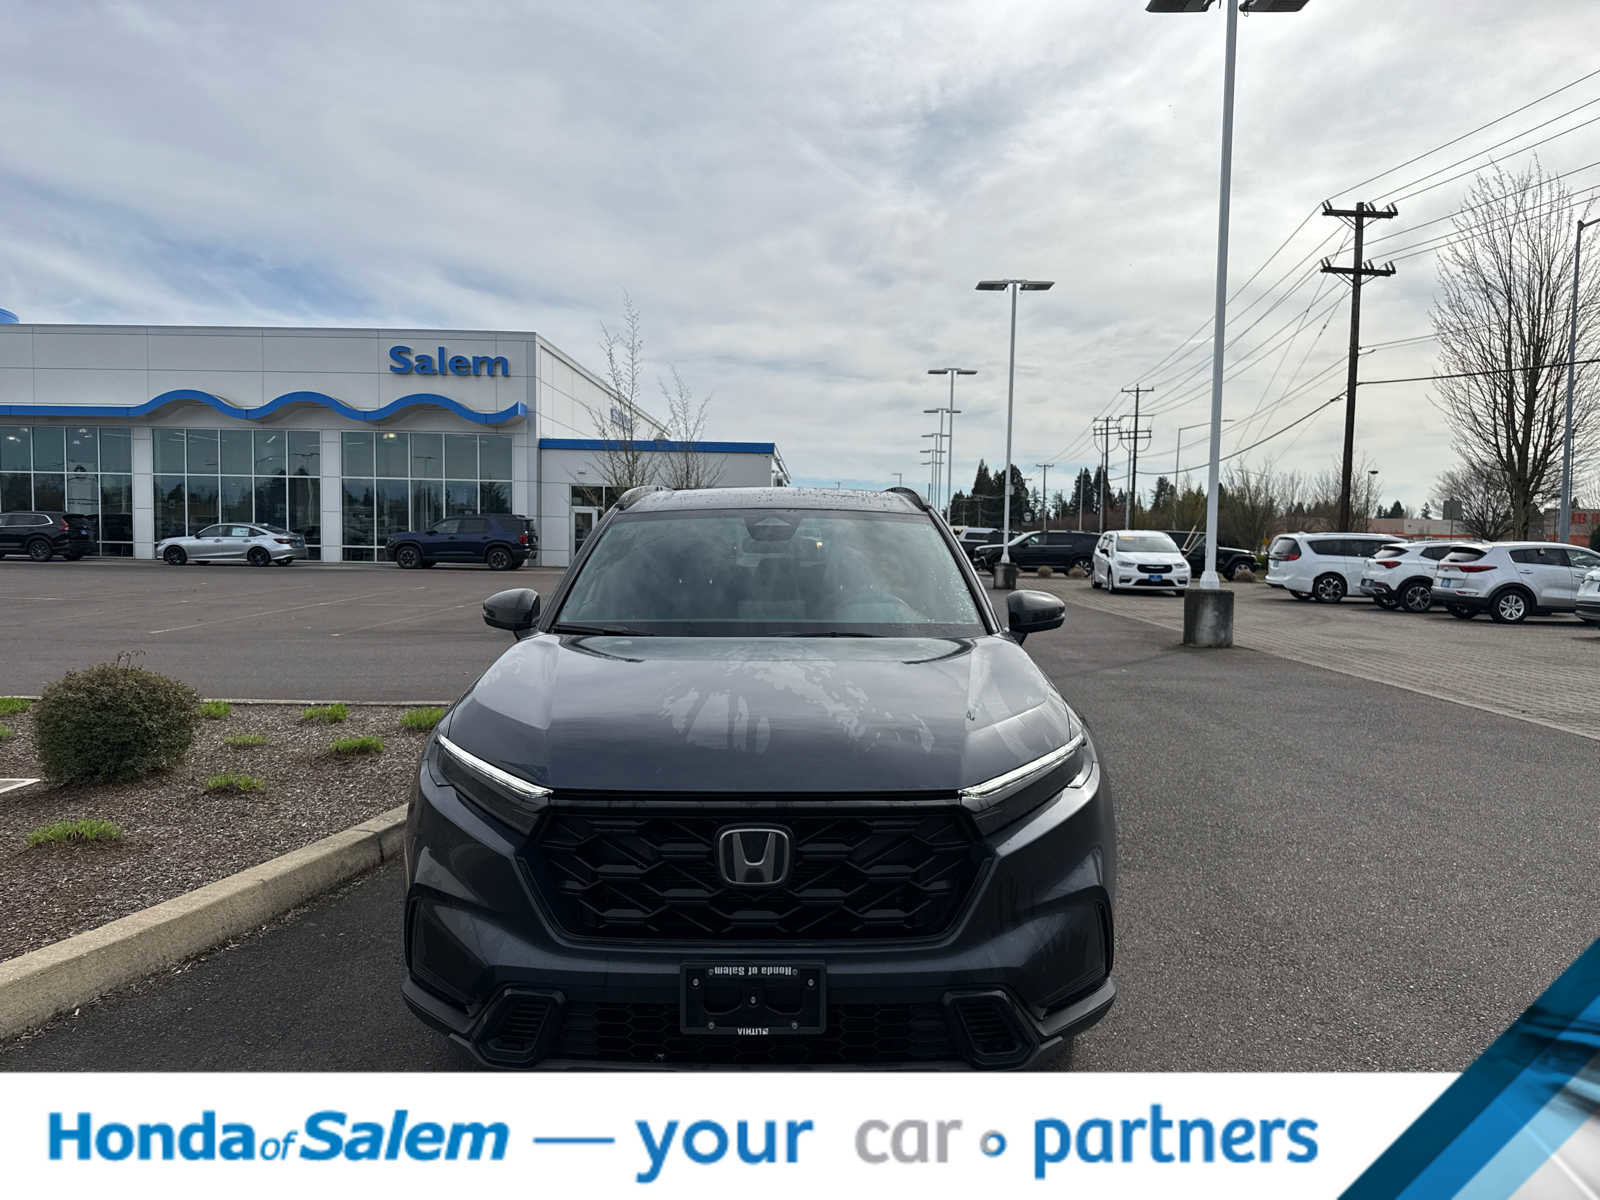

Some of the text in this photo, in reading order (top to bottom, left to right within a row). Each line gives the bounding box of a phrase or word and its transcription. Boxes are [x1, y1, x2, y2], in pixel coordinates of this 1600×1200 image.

[389, 345, 509, 377] Salem
[714, 965, 792, 975] Honda of Salem
[737, 1027, 762, 1036] LITHIA
